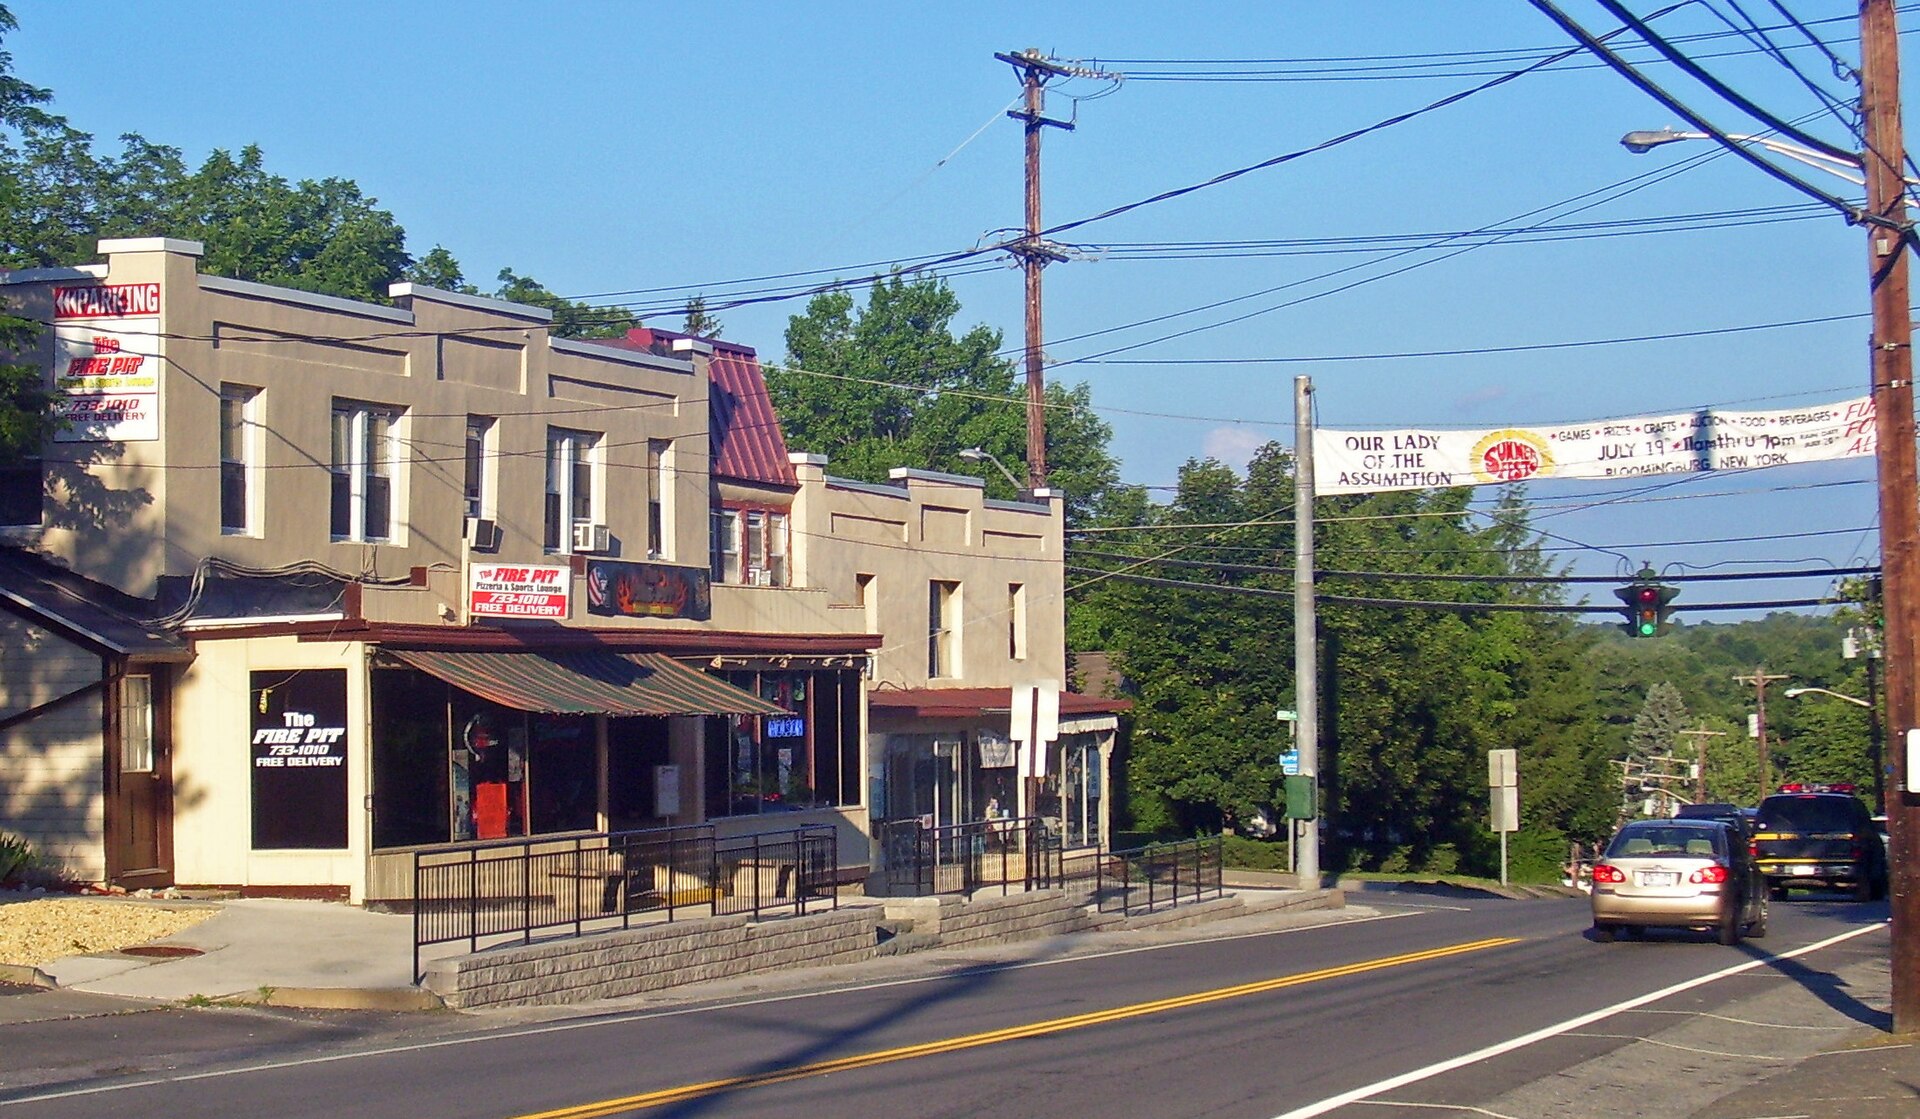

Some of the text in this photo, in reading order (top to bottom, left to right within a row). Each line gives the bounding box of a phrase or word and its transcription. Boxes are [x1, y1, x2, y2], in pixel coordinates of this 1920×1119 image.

[77, 284, 158, 314] PARKING
[92, 336, 120, 354] The
[66, 356, 145, 376] FIRE PIT
[72, 399, 139, 411] 733-1010
[65, 412, 146, 422] FREE DELIVERY
[1559, 429, 1591, 441] GAMES
[1644, 421, 1676, 434] CRAFTS
[1740, 416, 1766, 427] FOOD
[1779, 411, 1831, 426] BEVERAGES
[1844, 417, 1876, 438] FO
[1345, 434, 1440, 451] OUR LADY
[1598, 443, 1636, 460] JULY
[1717, 432, 1755, 449] thru
[1760, 434, 1796, 450] 7pm
[1846, 435, 1872, 456] AL
[1363, 453, 1425, 469] OF THE
[1720, 455, 1748, 469] NEW
[1754, 453, 1789, 466] YORK
[1338, 471, 1452, 486] ASSUMPTION
[493, 568, 530, 582] FIRE
[531, 569, 559, 584] PIT
[476, 582, 502, 590] Pizzeria
[510, 583, 534, 592] Sports
[536, 584, 562, 593] Lounge
[489, 593, 549, 605] 733-1010
[475, 602, 562, 615] FREE DELIVERY
[283, 712, 315, 727] The
[252, 727, 345, 744] FIRE PIT
[269, 744, 329, 755] 733-1010
[256, 756, 343, 767] FREE DELIVERY
